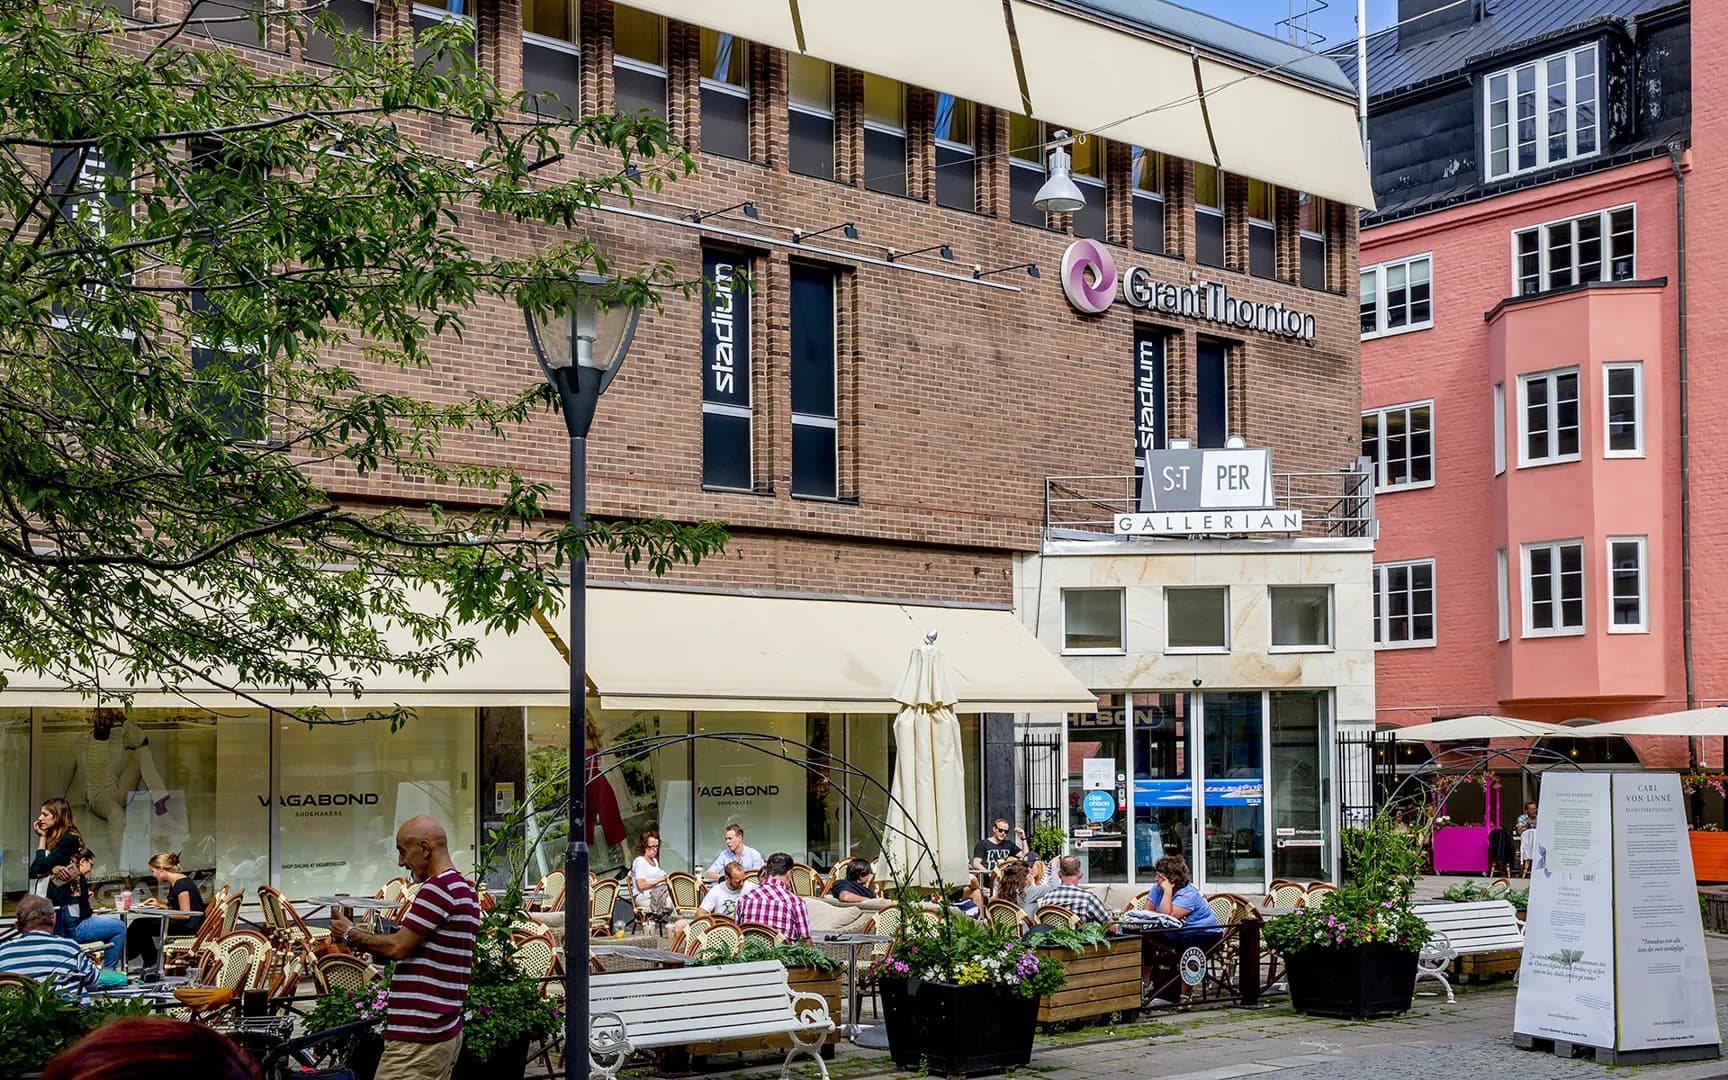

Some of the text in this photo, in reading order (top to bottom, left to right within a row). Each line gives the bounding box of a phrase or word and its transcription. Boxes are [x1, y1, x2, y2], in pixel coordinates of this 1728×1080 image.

[711, 263, 734, 394] stadium
[1137, 340, 1155, 450] stadium
[1162, 464, 1250, 492] S:T PER
[1118, 513, 1298, 532] GALLERIAN
[697, 785, 780, 797] AGABOND
[1637, 784, 1659, 792] CARL
[1625, 793, 1673, 802] VON LINNÉ
[295, 810, 343, 818] SHOEMAKERS
